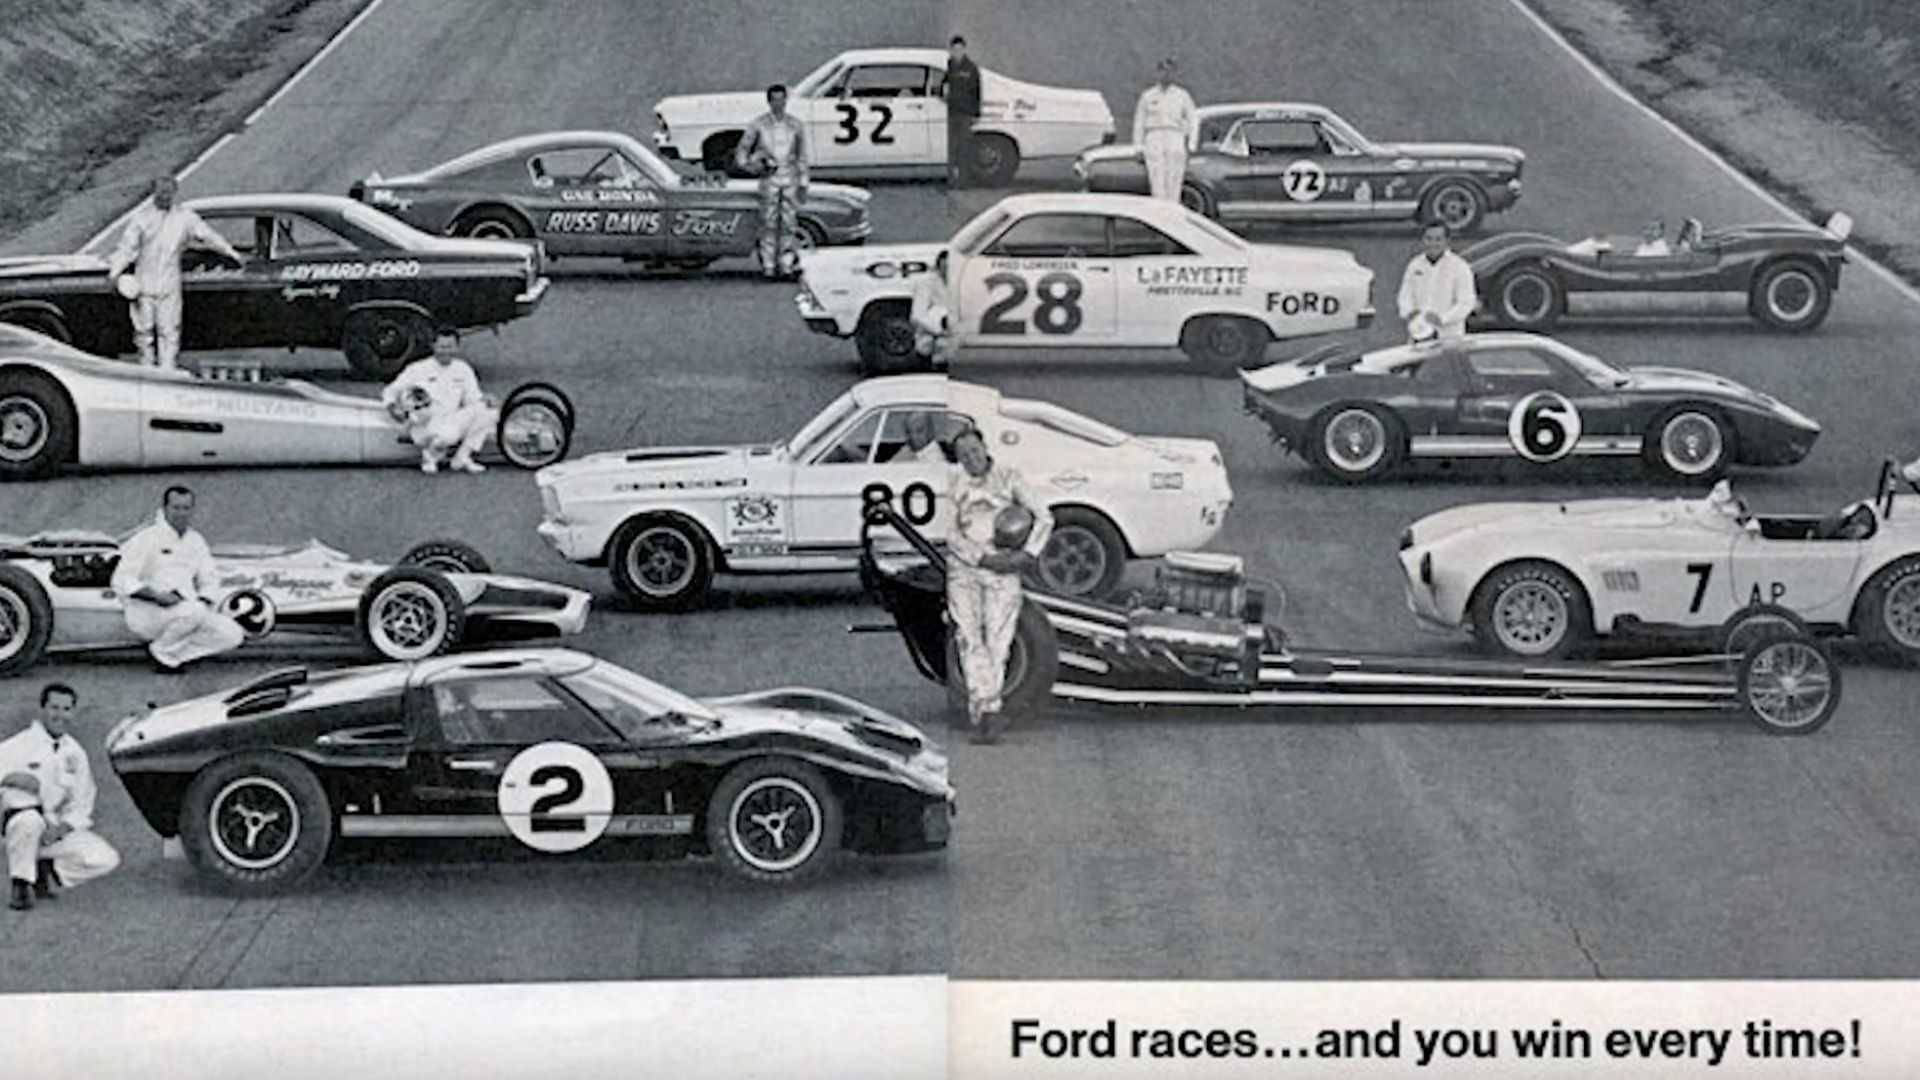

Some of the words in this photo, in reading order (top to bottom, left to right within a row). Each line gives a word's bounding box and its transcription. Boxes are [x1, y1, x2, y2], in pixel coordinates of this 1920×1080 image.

[834, 105, 895, 144] 32
[1288, 171, 1319, 192] 72
[546, 210, 599, 234] RUSS
[604, 211, 661, 235] DAVIS
[673, 209, 743, 235] Ford
[365, 259, 420, 277] FORD
[979, 272, 1083, 335] 28
[1266, 291, 1340, 316] FORD
[1522, 396, 1567, 455] 6
[862, 482, 936, 526] 80
[1687, 563, 1713, 613] 7
[229, 591, 267, 633] 2
[529, 765, 586, 832] 2
